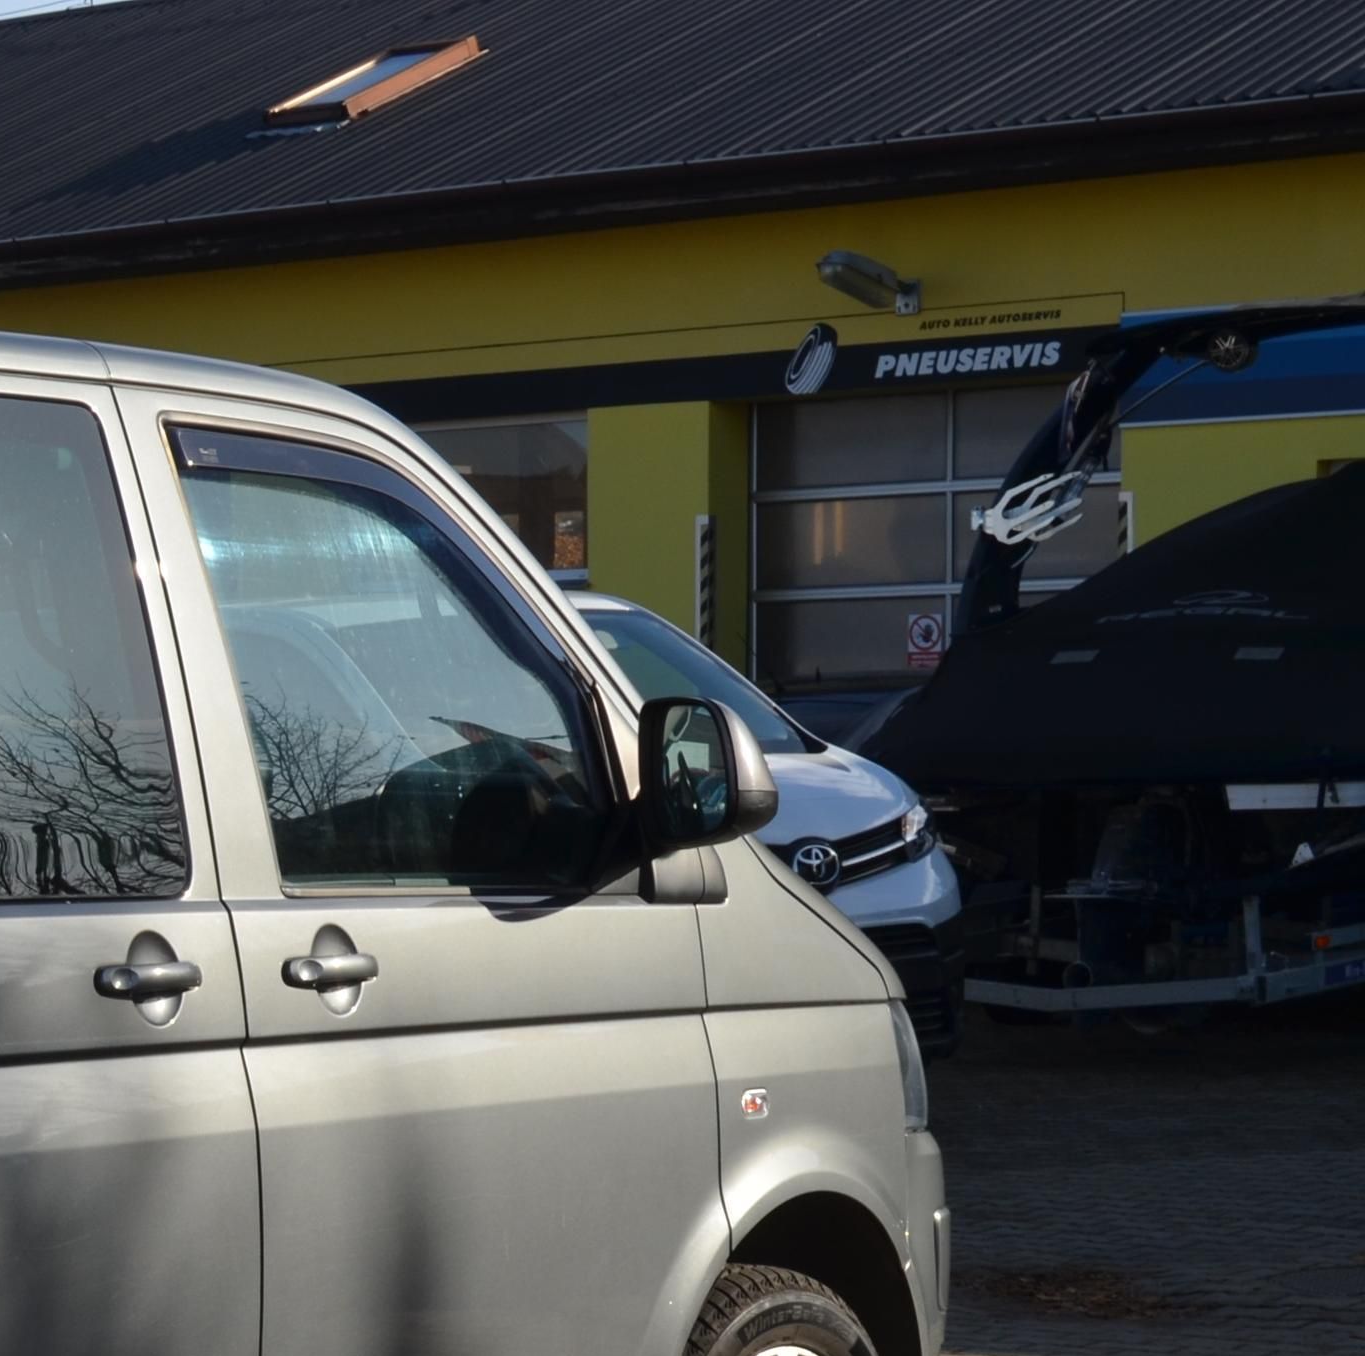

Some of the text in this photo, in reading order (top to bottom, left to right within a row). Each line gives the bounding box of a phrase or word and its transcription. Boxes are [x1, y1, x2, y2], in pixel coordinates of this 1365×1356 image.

[919, 309, 1062, 331] AUTO KELLY AUTOSERVIS
[874, 340, 1062, 379] PNEUSERVIS
